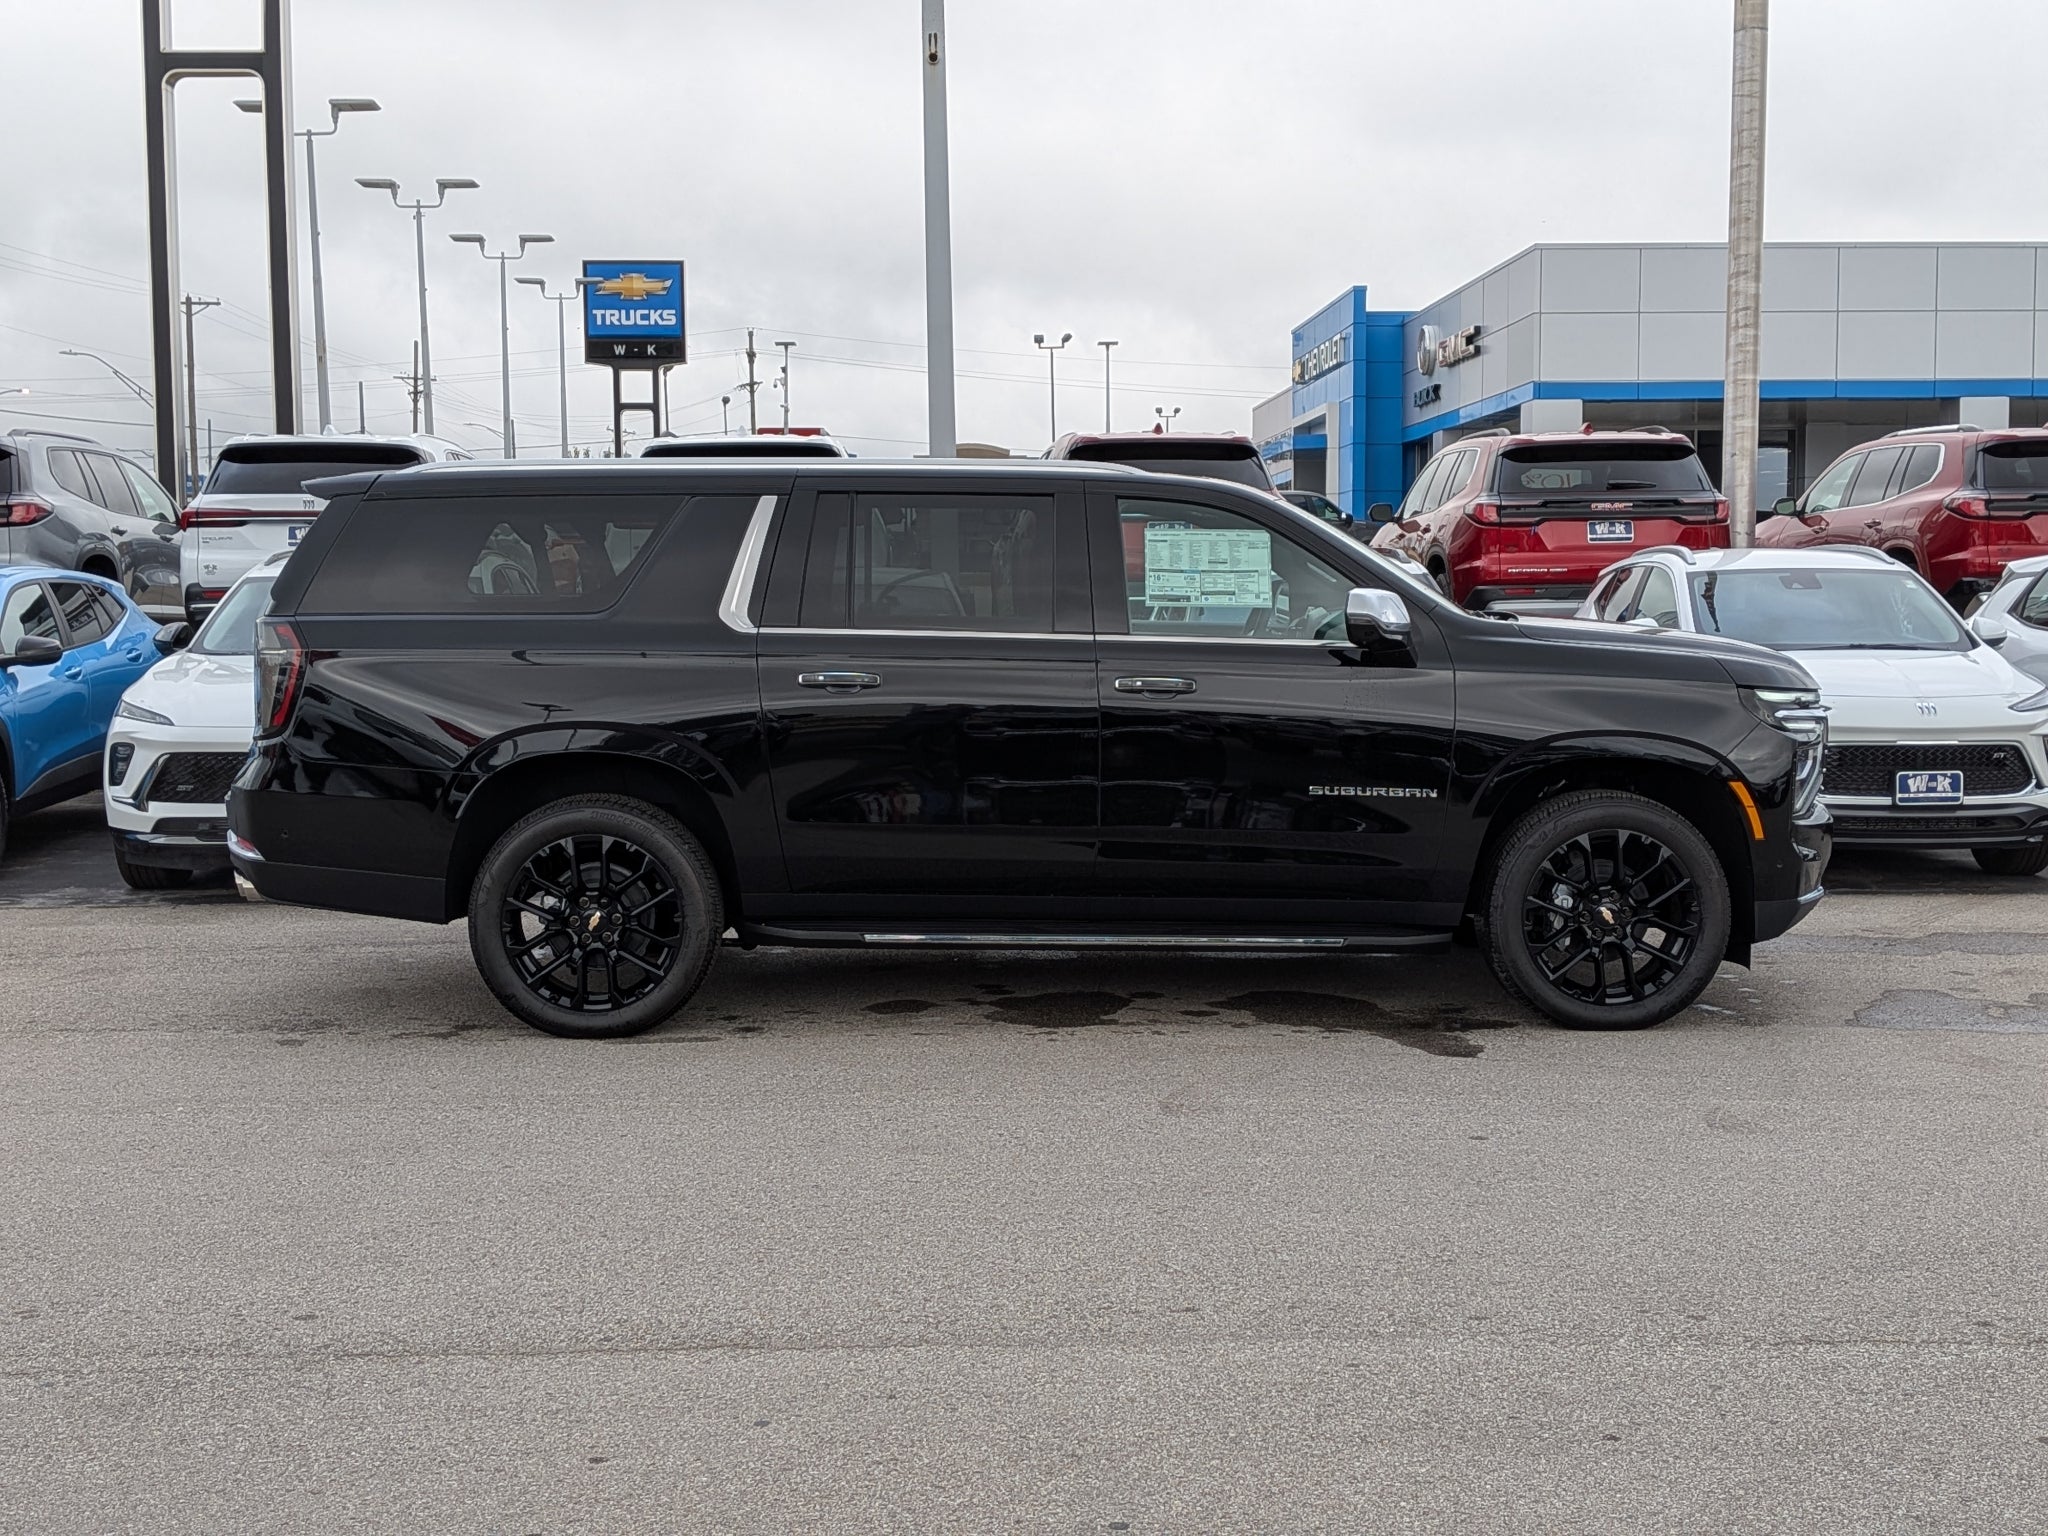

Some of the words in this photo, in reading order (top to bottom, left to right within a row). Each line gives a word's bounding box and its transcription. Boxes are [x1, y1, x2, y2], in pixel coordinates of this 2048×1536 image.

[592, 309, 677, 326] TRUCKS
[1436, 325, 1481, 368] GMC
[1304, 332, 1346, 382] CHEVROLET
[1413, 384, 1442, 408] BUICK
[1591, 502, 1634, 512] GMC
[1594, 522, 1627, 535] W-K
[1308, 785, 1438, 798] SUBURBAN
[1907, 774, 1953, 793] W-K
